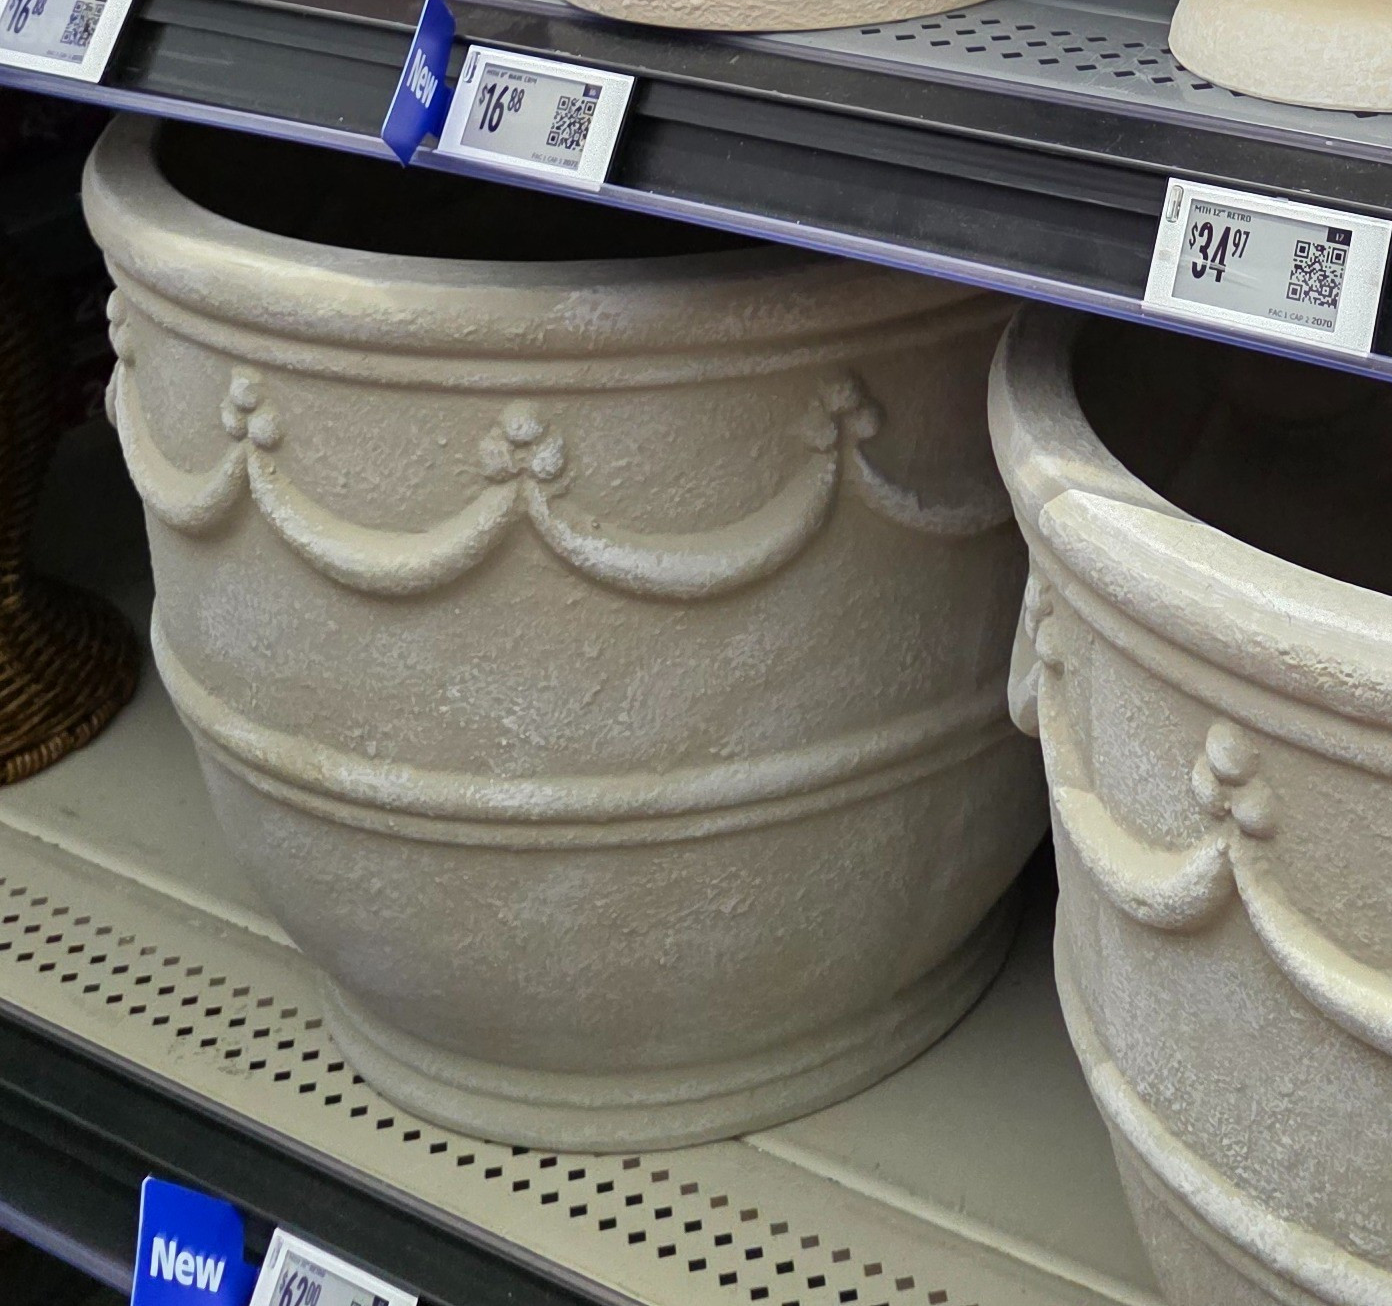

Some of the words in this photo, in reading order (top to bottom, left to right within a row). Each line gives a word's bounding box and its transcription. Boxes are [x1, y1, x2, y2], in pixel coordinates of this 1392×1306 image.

[406, 48, 438, 109] New
[1194, 204, 1211, 215] MTH
[1227, 211, 1252, 223] RETRO
[1268, 308, 1283, 318] FAC
[1290, 313, 1304, 322] CAP
[1311, 317, 1332, 328] 2070
[150, 1236, 225, 1293] New
